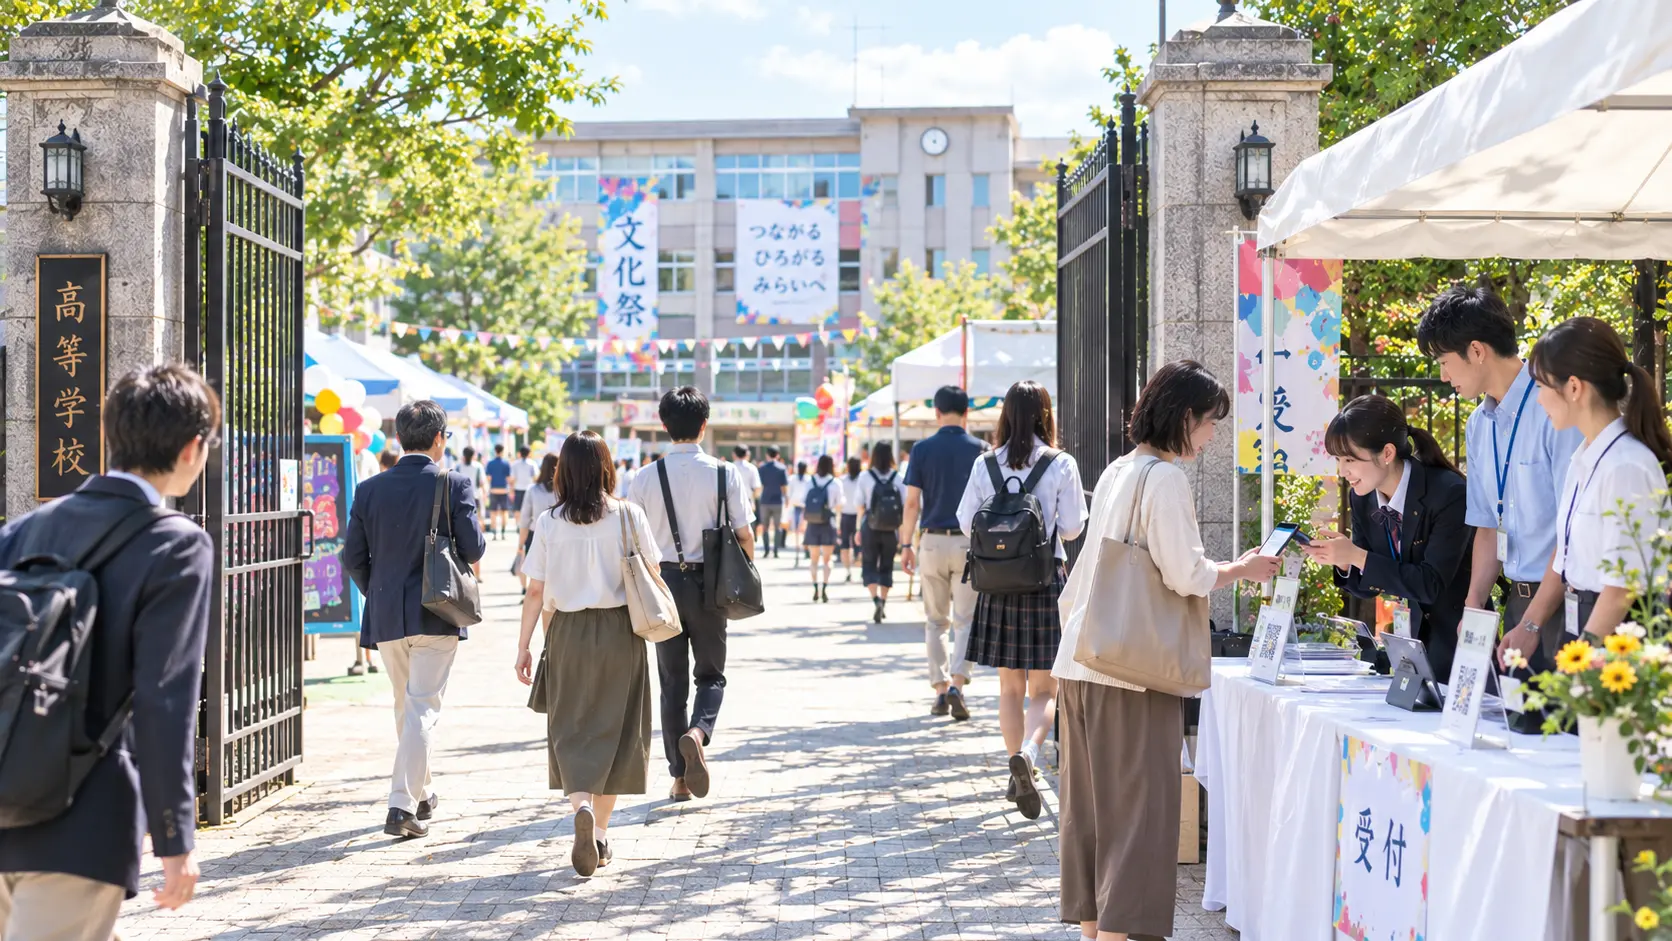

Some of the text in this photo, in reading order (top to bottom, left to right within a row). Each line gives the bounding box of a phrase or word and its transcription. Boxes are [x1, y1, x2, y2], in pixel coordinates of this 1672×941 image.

[750, 223, 821, 240] つながる
[613, 216, 646, 327] 文化祭
[755, 249, 825, 267] ひろがる
[753, 276, 827, 294] みらいへ
[51, 280, 90, 477] 高等学校
[1354, 807, 1407, 888] 受付
